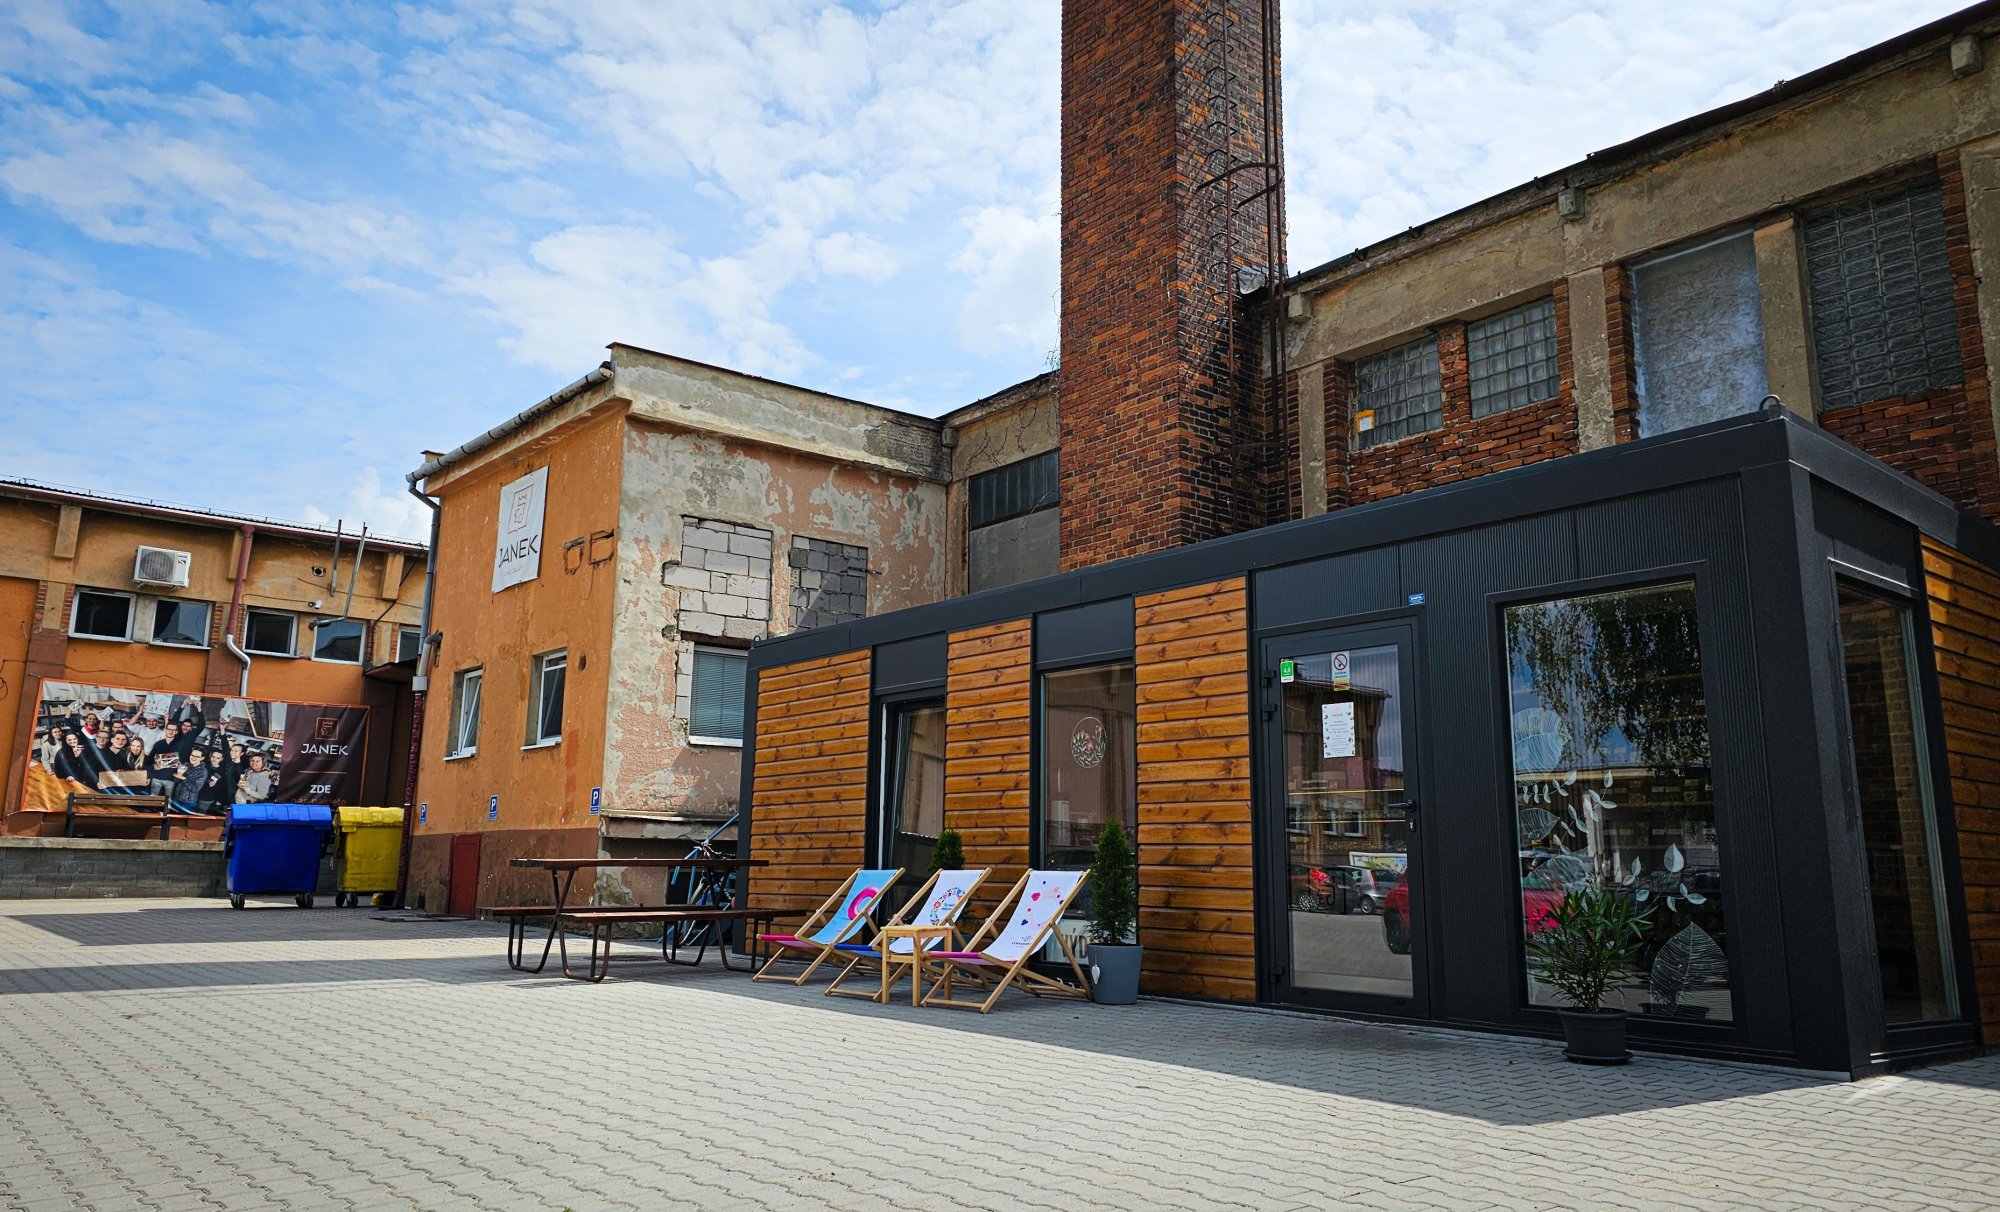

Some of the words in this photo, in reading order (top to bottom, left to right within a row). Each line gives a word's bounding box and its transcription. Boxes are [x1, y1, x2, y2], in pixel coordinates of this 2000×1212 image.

[499, 535, 538, 568] JANEK
[300, 743, 349, 756] JANEK
[309, 784, 331, 794] ZDE
[592, 790, 599, 805] P
[490, 798, 497, 811] P
